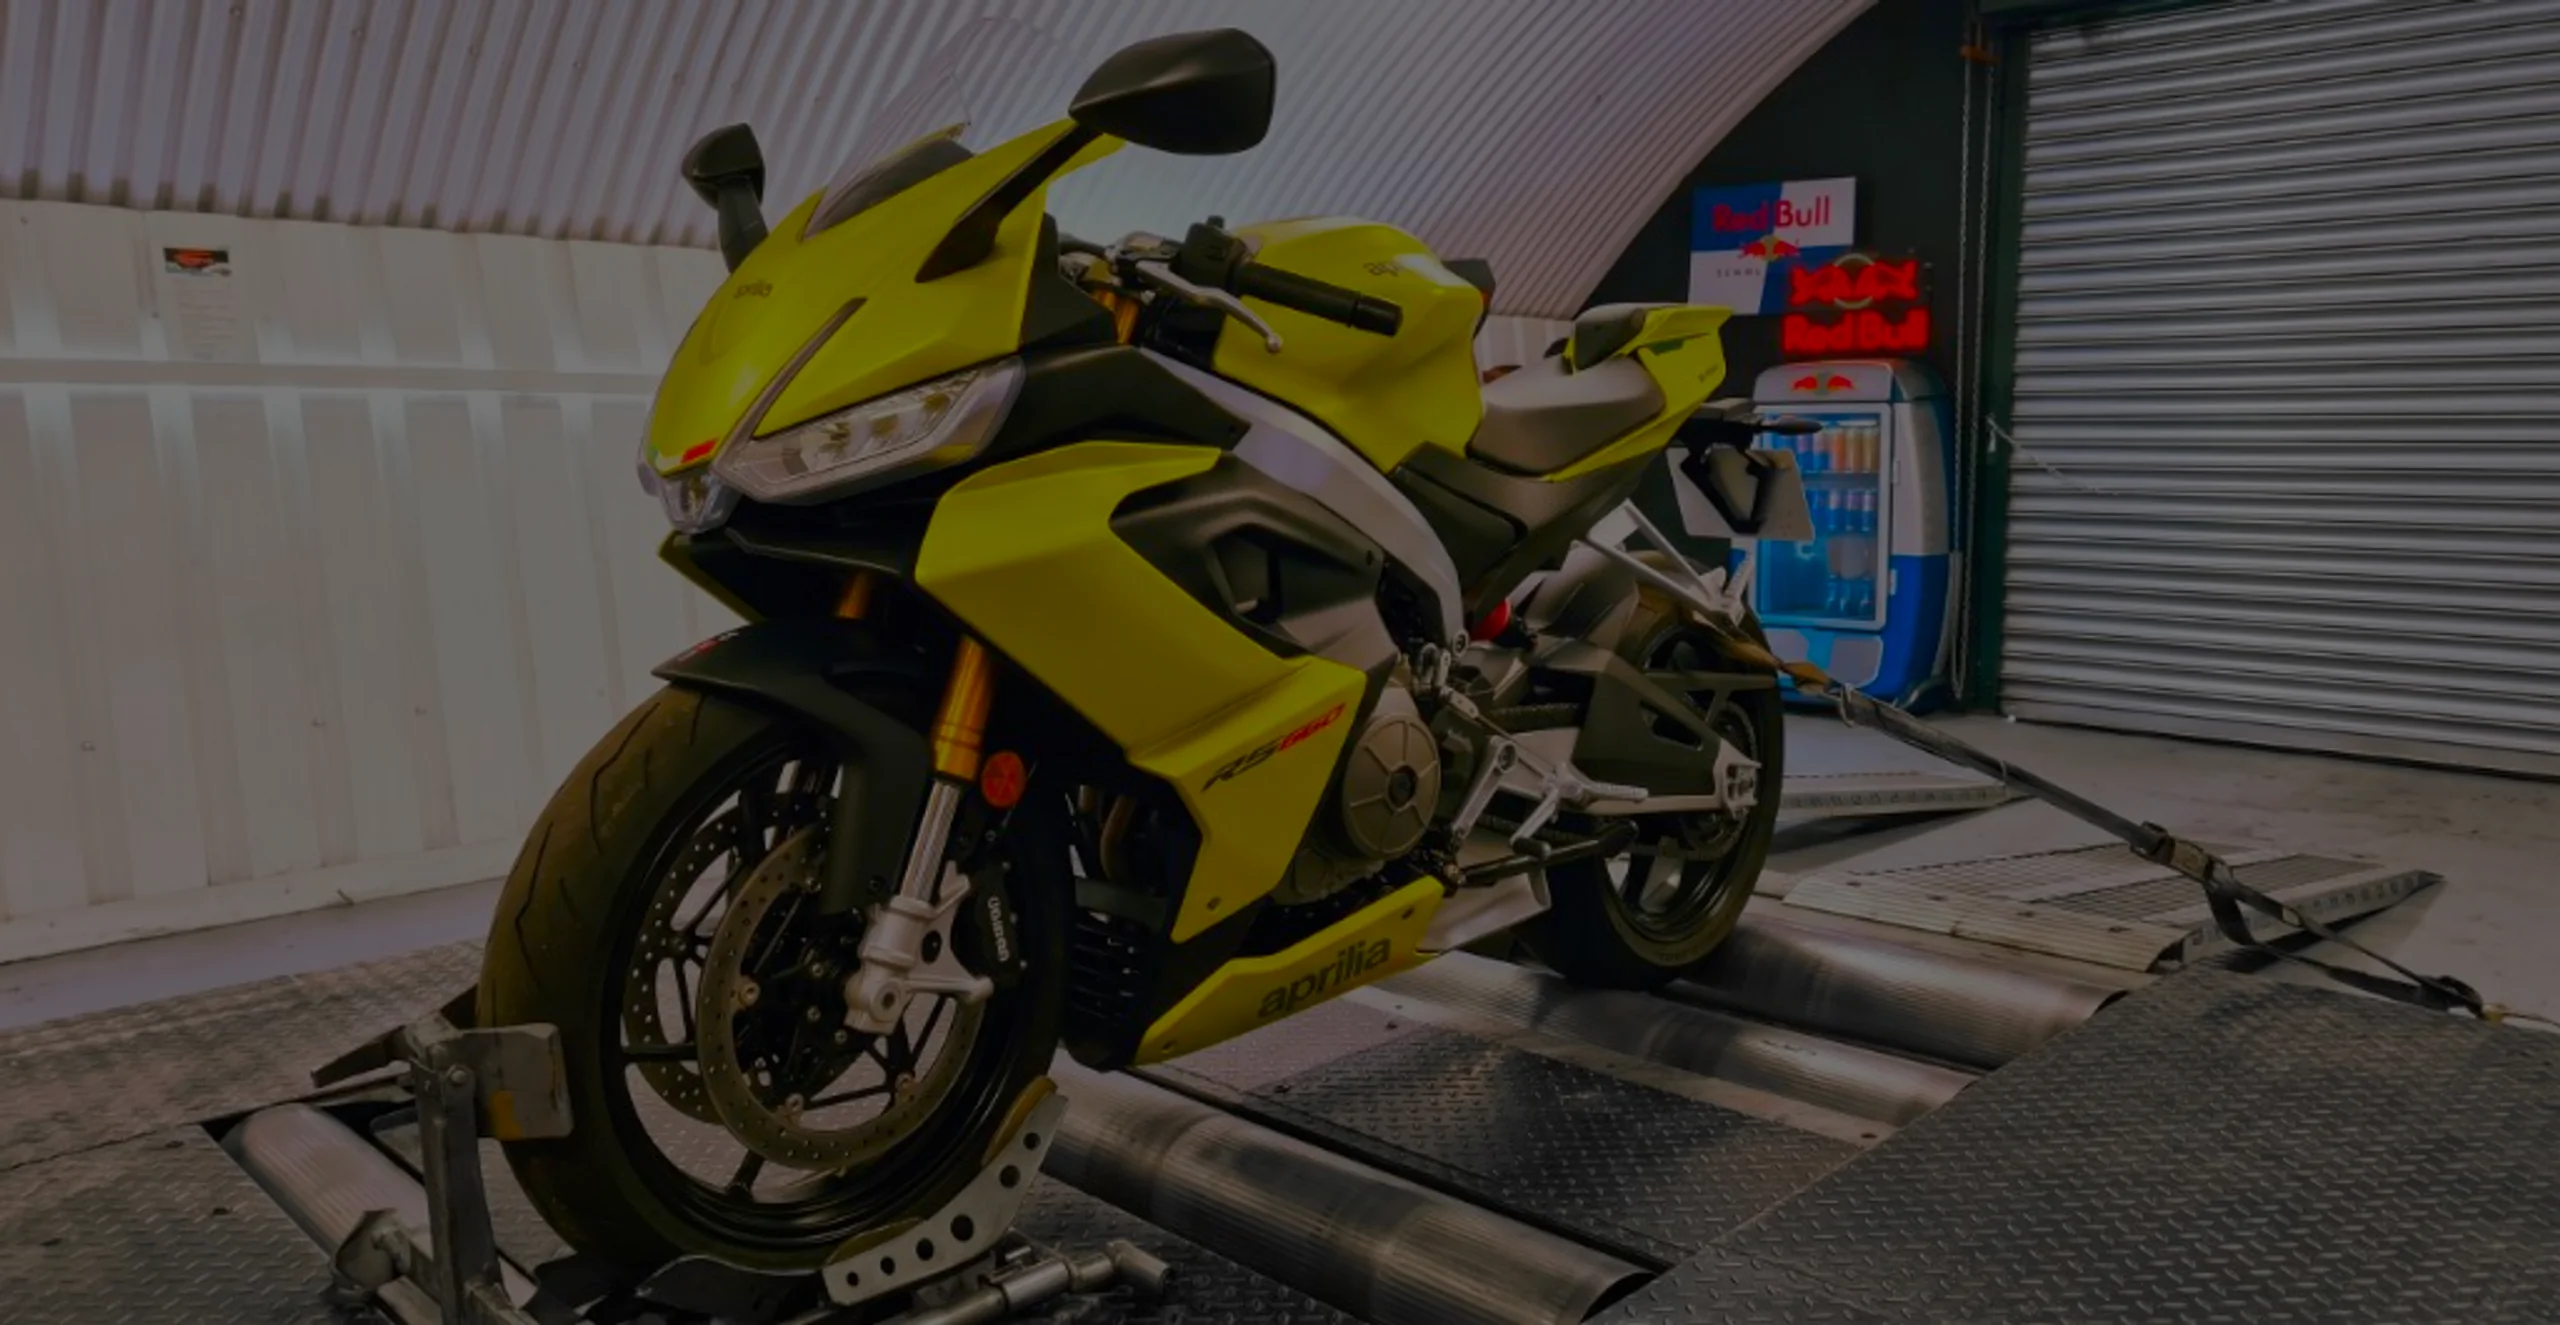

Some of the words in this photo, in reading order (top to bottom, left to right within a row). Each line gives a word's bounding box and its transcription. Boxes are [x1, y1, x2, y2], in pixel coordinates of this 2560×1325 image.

[1713, 203, 1768, 231] Red
[1775, 195, 1831, 227] Bull
[1783, 311, 1853, 353] Red
[1859, 306, 1930, 350] Bull
[1258, 938, 1391, 1018] aprilia
